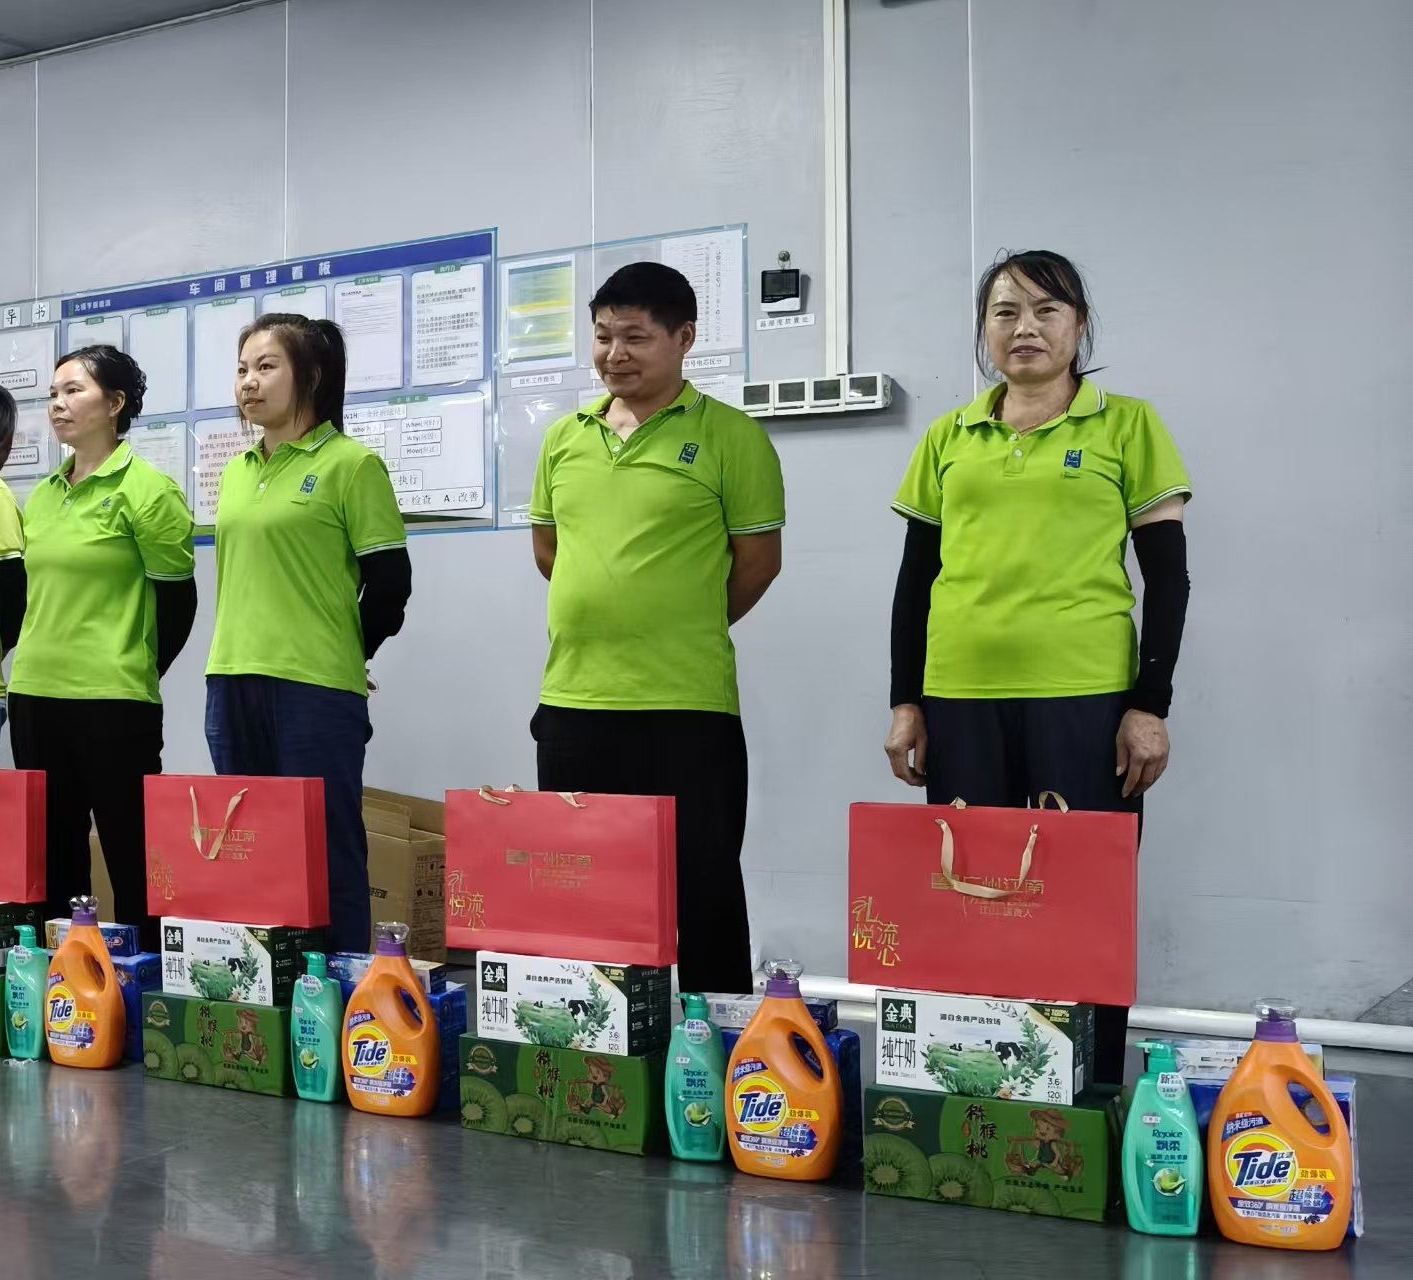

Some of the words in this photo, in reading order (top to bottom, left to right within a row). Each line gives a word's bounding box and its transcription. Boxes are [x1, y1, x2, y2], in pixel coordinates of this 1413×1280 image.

[189, 261, 331, 296] 车间管理看板
[483, 964, 506, 984] 金典
[49, 999, 72, 1022] Tide
[885, 1002, 915, 1024] 金典
[352, 1040, 387, 1066] Tide
[881, 1037, 916, 1069] 纯牛奶
[739, 1092, 782, 1123] Tide
[1152, 1129, 1183, 1139] Rejoice
[1156, 1140, 1180, 1151] 飘柔
[1233, 1151, 1291, 1187] Tide
